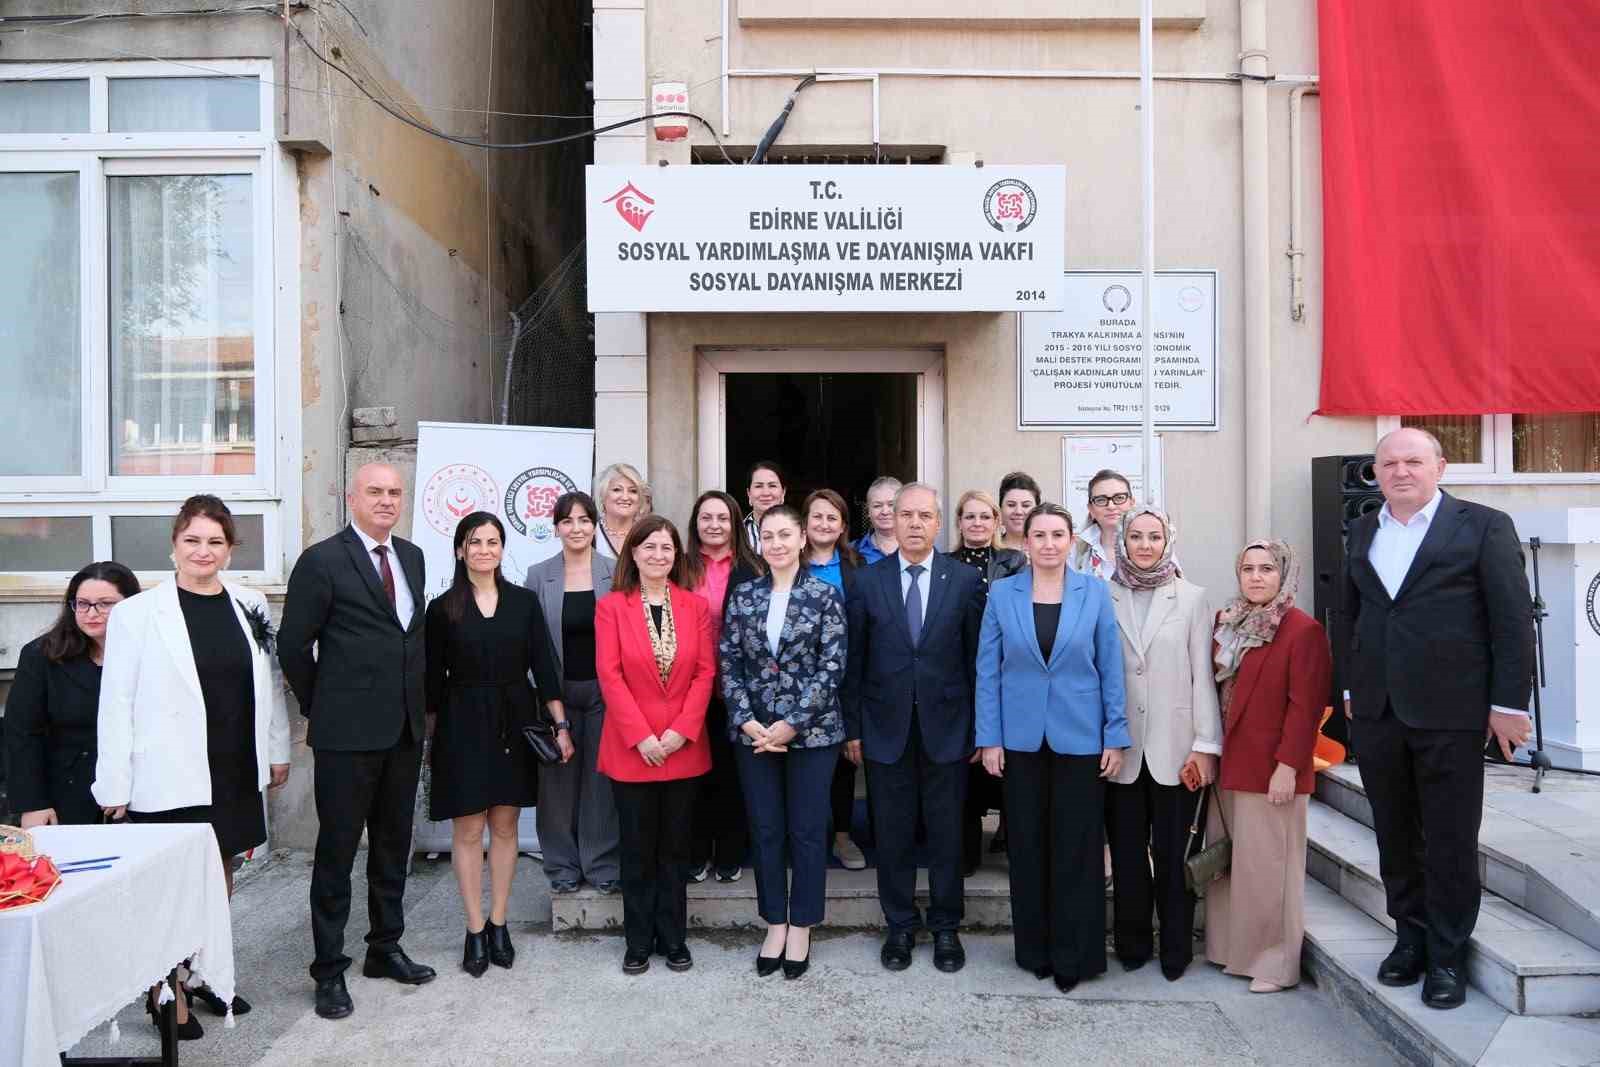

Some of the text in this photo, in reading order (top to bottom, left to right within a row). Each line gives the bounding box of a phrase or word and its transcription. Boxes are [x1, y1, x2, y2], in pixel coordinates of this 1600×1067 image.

[809, 180, 842, 200] T.C.
[750, 207, 903, 230] EDİRNE VALİLİĞİ
[617, 241, 1033, 265] SOSYAL YARDIMLAŞMA VE DAYANIŞMA VAKFI
[689, 268, 962, 295] SOSYAL DAYANIŞMA MERKEZİ
[1016, 290, 1046, 301] 2014
[1099, 319, 1136, 327] BURADA
[1051, 331, 1085, 339] TRAKYA
[1087, 331, 1134, 339] KALKINMA
[1044, 344, 1065, 352] 2015
[1059, 356, 1093, 364] DESTEK
[1095, 356, 1141, 364] PROGRAMI
[1154, 356, 1200, 365] PSAMINDA
[1073, 368, 1118, 377] KADINLAR
